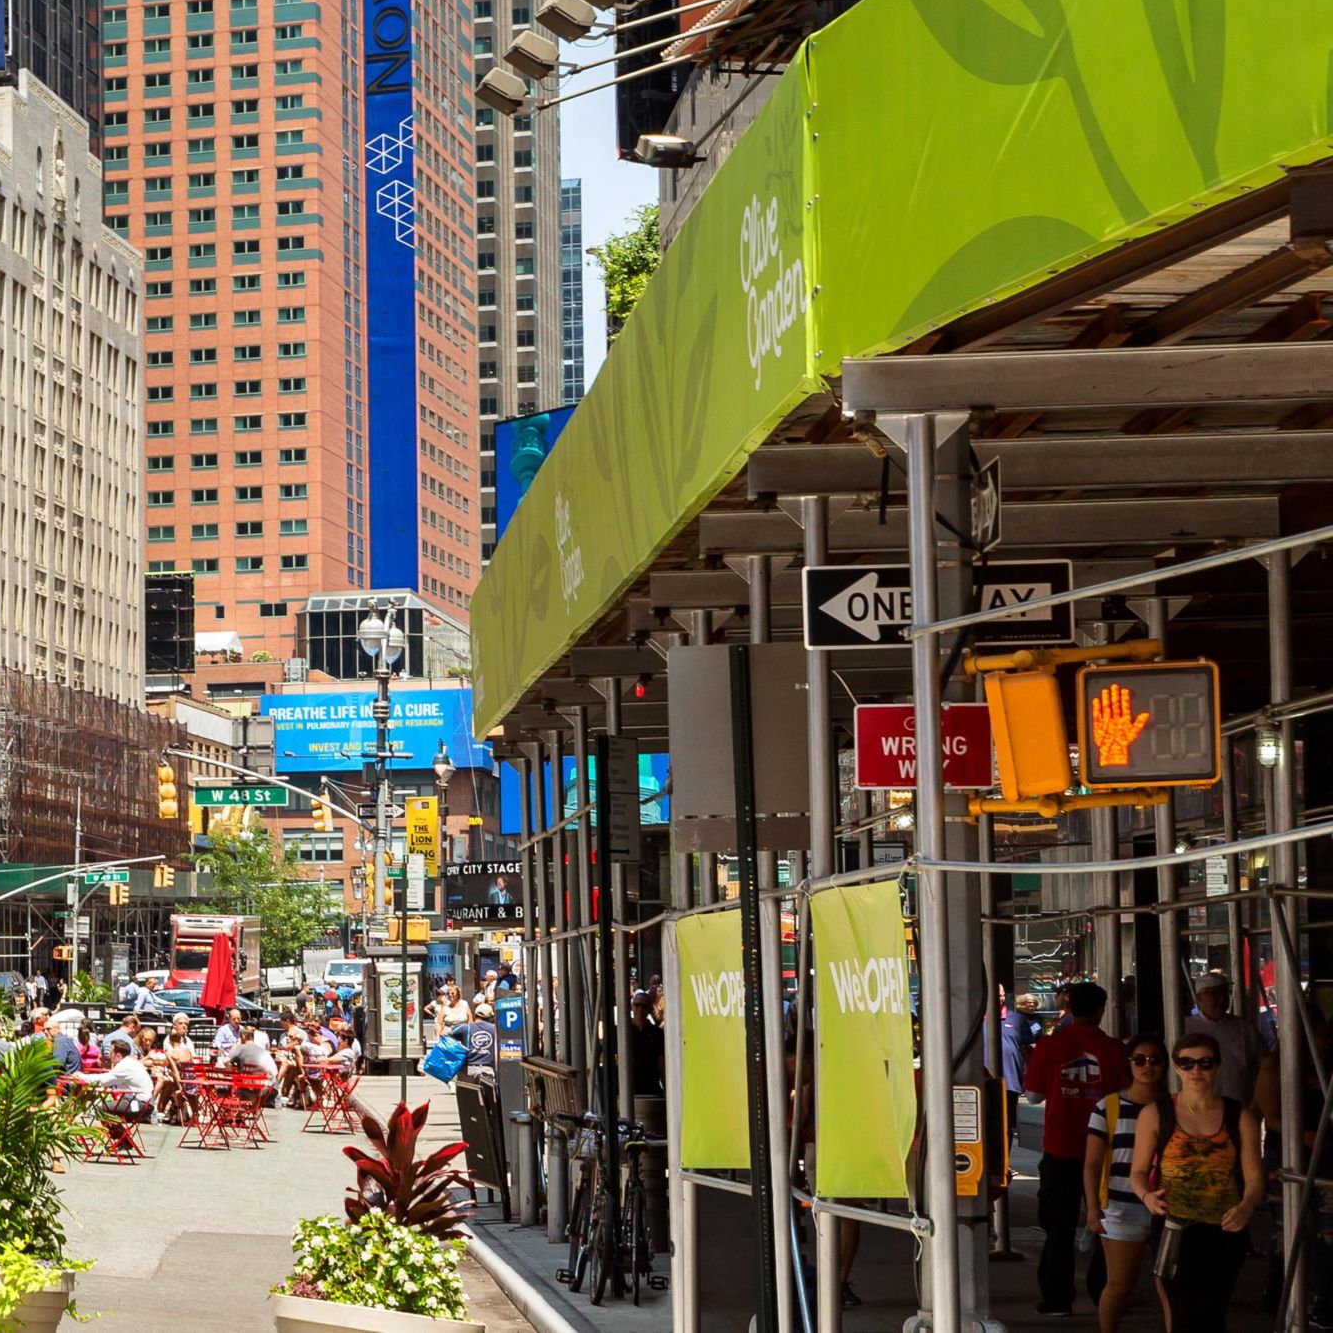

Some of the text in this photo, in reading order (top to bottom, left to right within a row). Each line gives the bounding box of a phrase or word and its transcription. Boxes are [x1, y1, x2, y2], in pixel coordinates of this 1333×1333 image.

[741, 194, 779, 293] Olive
[748, 258, 806, 390] Garden
[269, 707, 327, 721] BREATHE
[331, 705, 356, 719] LIFE
[393, 704, 403, 717] A
[406, 703, 443, 717] CURE.
[306, 721, 350, 730] PULMONARY
[352, 720, 377, 728] FIBROS
[309, 741, 361, 752] INVEST AND
[881, 736, 967, 757] WRNG
[212, 788, 271, 802] W 48 St
[411, 833, 432, 846] LION
[463, 865, 483, 874] CITY
[487, 863, 521, 873] STAGE
[498, 907, 506, 918] &
[506, 1011, 518, 1028] P
